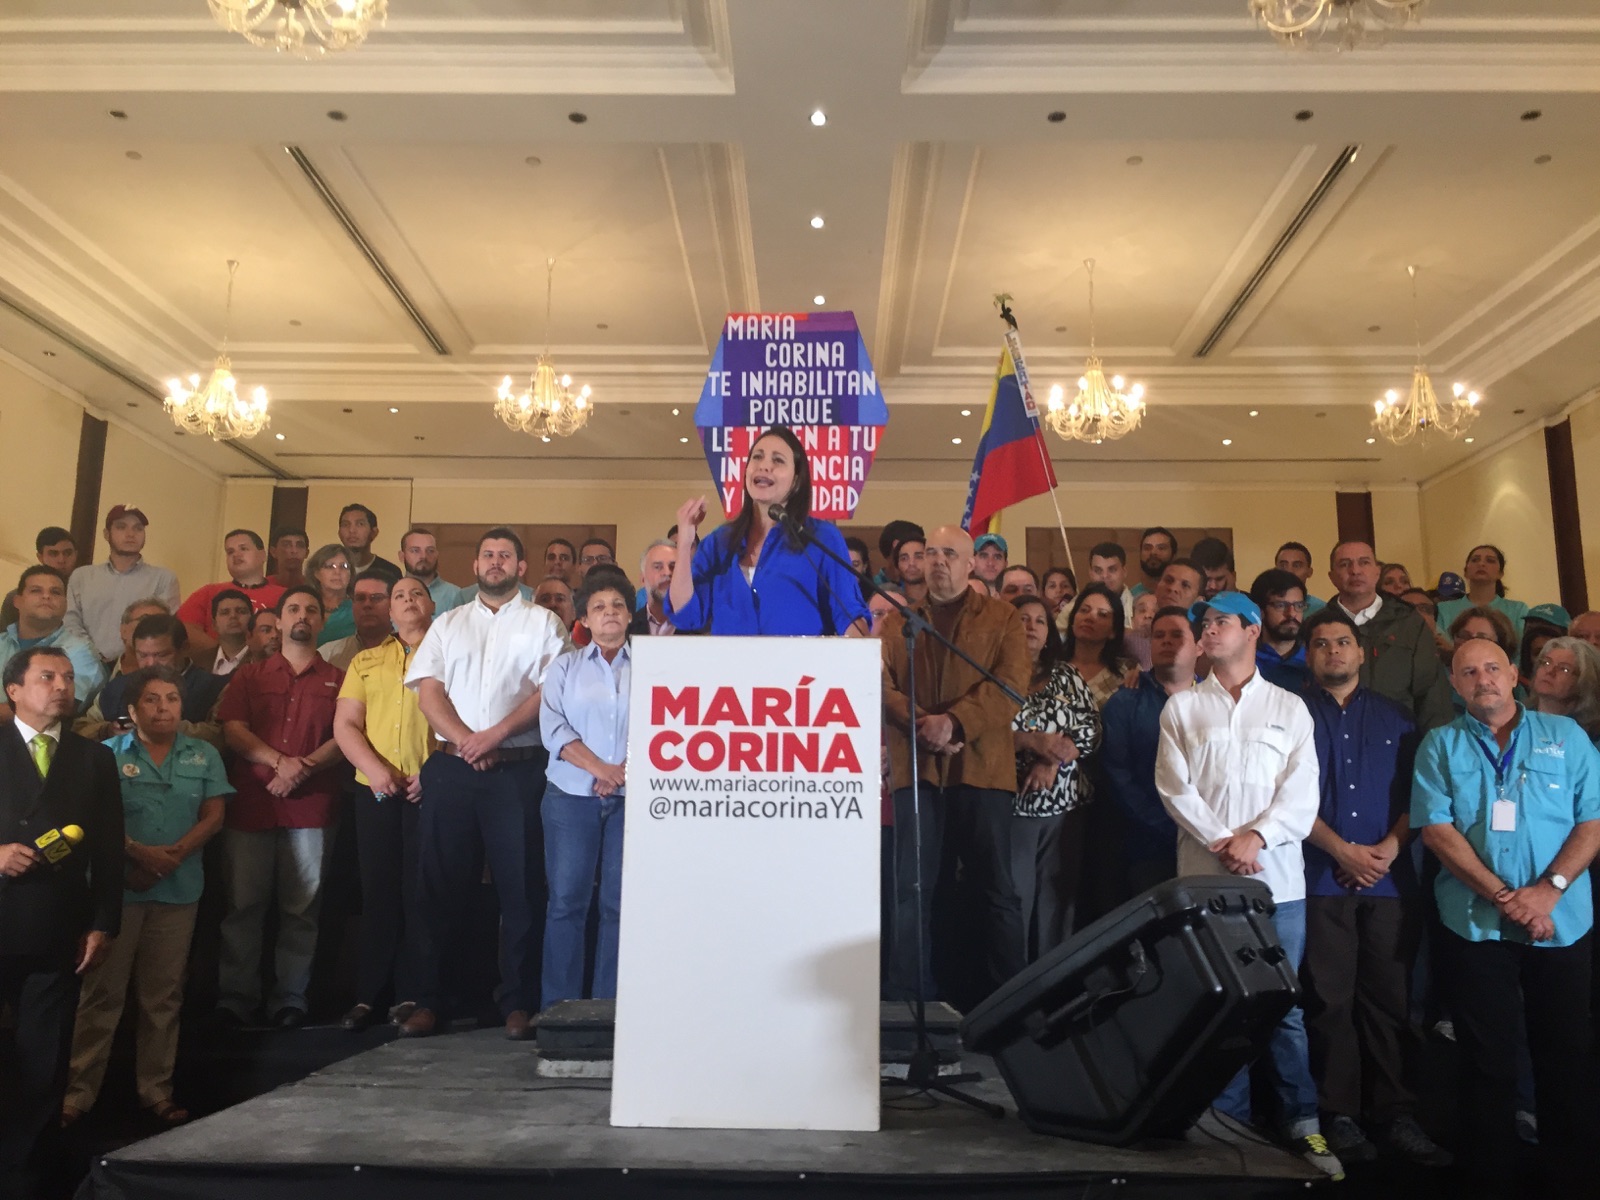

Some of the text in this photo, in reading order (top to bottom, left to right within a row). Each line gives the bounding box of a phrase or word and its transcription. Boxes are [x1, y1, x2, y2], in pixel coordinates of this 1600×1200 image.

[765, 341, 845, 368] CORINA
[708, 370, 876, 397] TE INHABILITAN
[750, 398, 833, 424] PORQUE
[712, 427, 734, 452] LE
[828, 425, 841, 451] A
[850, 426, 876, 451] TU
[722, 486, 736, 512] Y
[651, 675, 861, 728] MARÍA
[648, 730, 863, 773] CORINA
[649, 775, 863, 793] www.mariacorina.com
[649, 795, 863, 820] @mariacorinaYA
